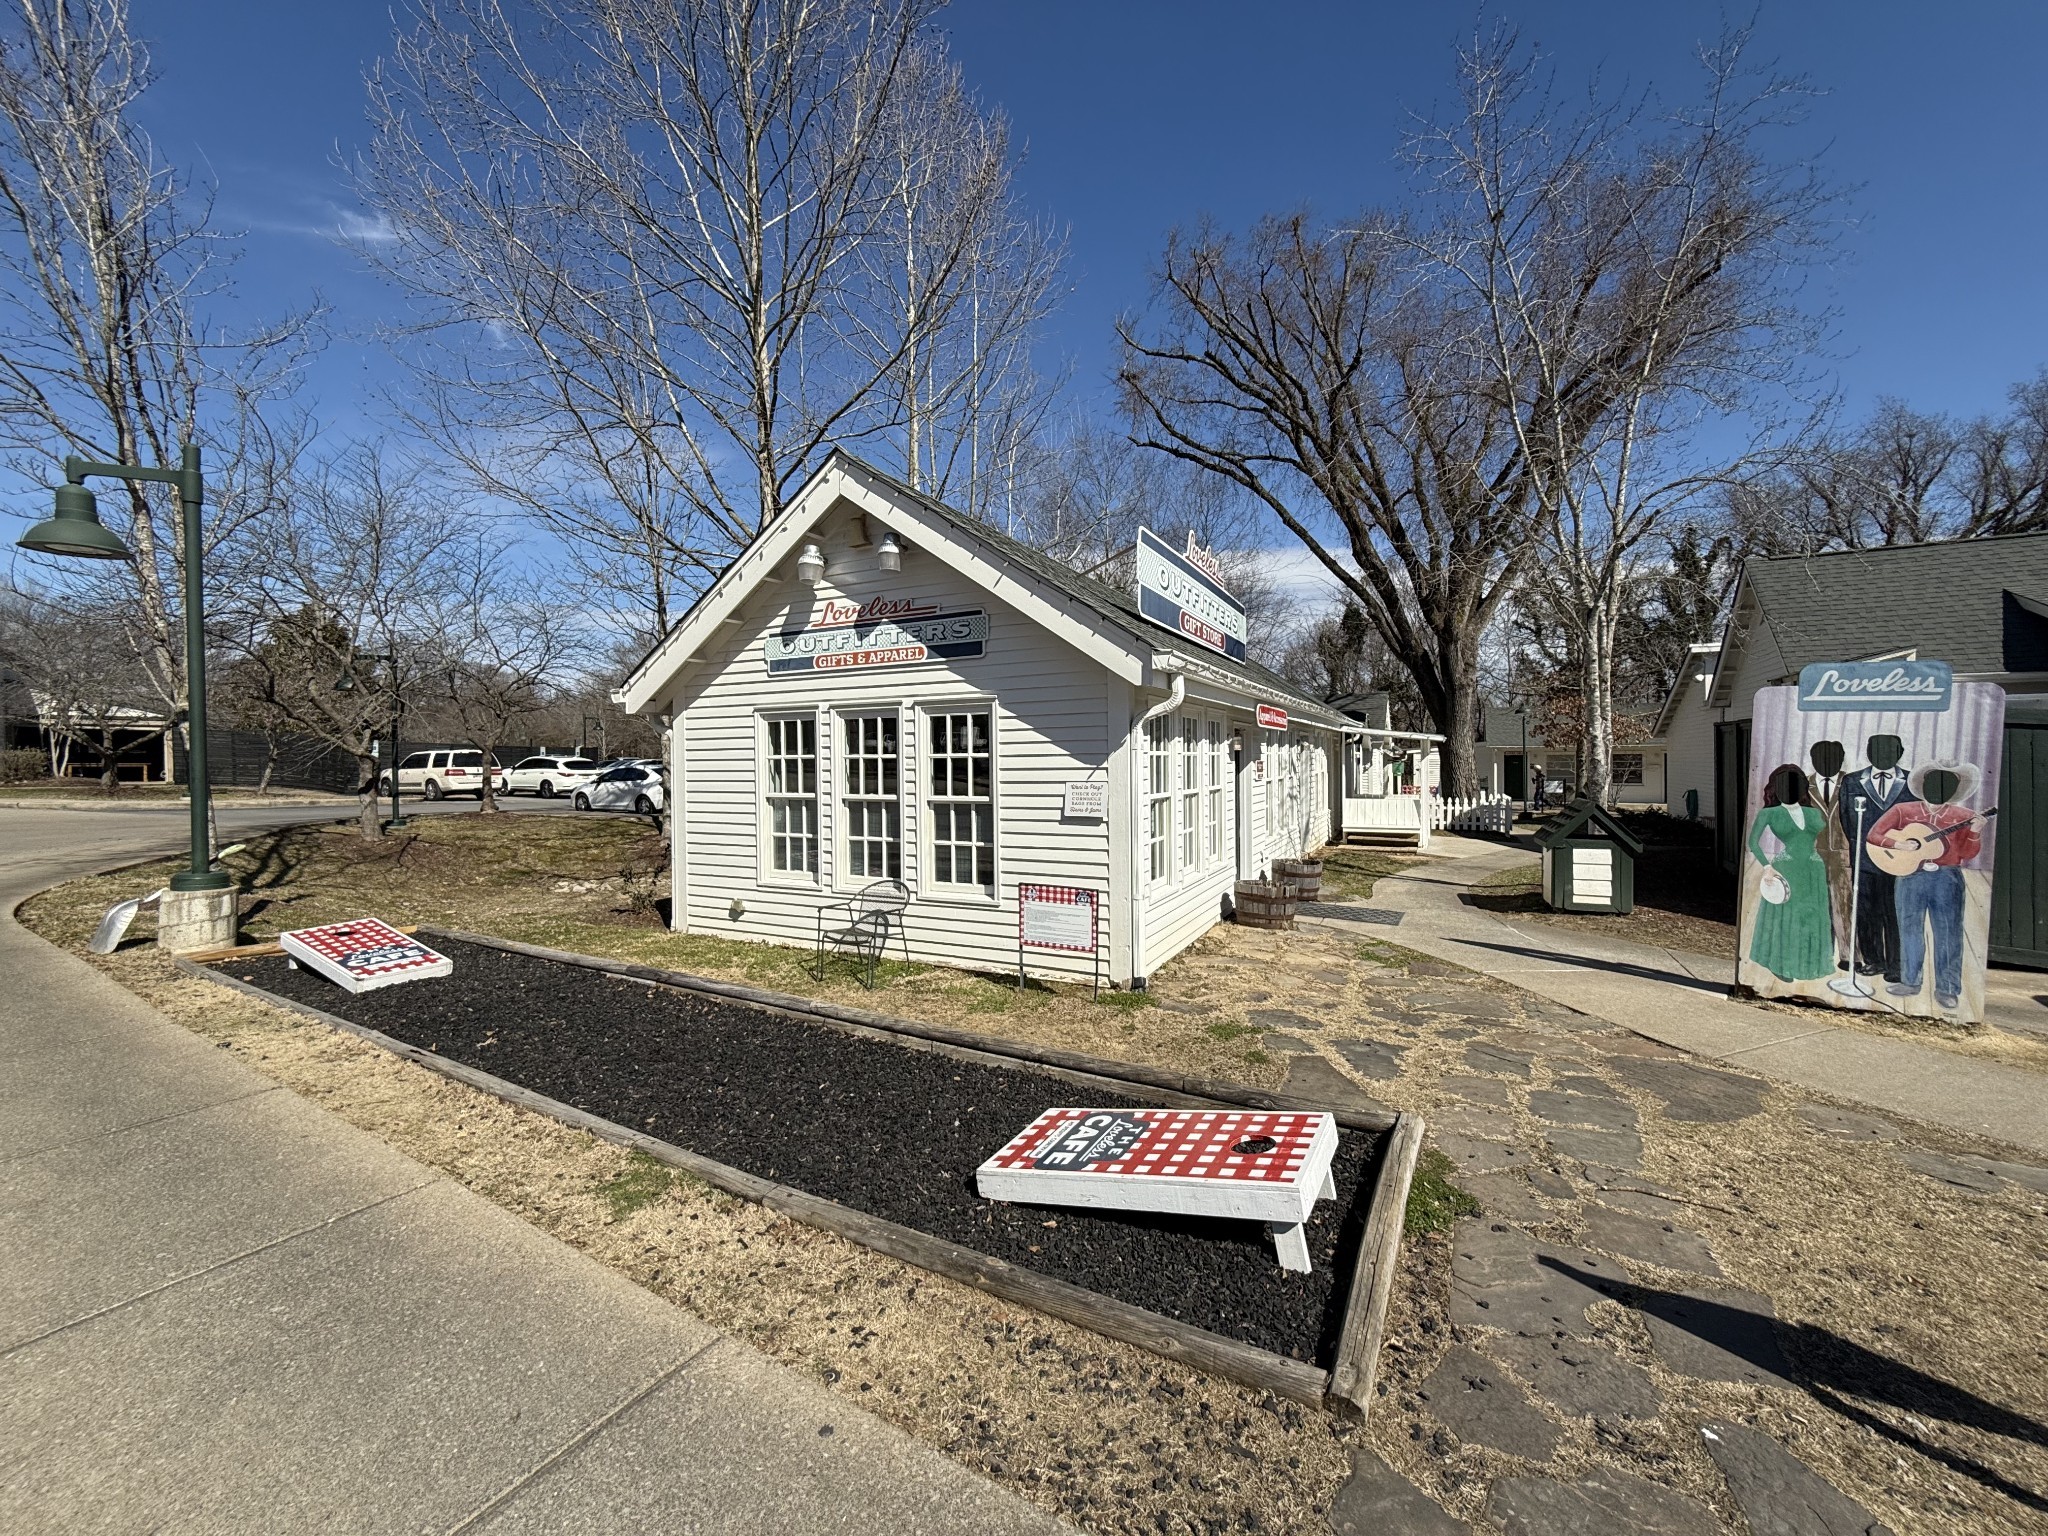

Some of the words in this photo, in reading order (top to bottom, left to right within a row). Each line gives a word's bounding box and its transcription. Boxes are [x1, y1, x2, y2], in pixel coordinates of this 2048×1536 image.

[1183, 531, 1224, 586] Loveless
[811, 595, 940, 628] Loveless
[1158, 565, 1239, 635] OUTFITTERS
[779, 620, 972, 655] OUTFITTERS
[1184, 614, 1202, 636] GIFT
[1202, 624, 1222, 647] STORE
[818, 653, 854, 668] GIFTS
[857, 652, 866, 665] &
[868, 647, 923, 664] APPAREL
[1803, 667, 1945, 701] Loveless
[1090, 783, 1104, 791] Play?
[347, 949, 424, 966] CAFE
[1043, 1115, 1113, 1165] CAFE
[1081, 1119, 1134, 1161] Loveless
[1107, 1126, 1143, 1156] THE
